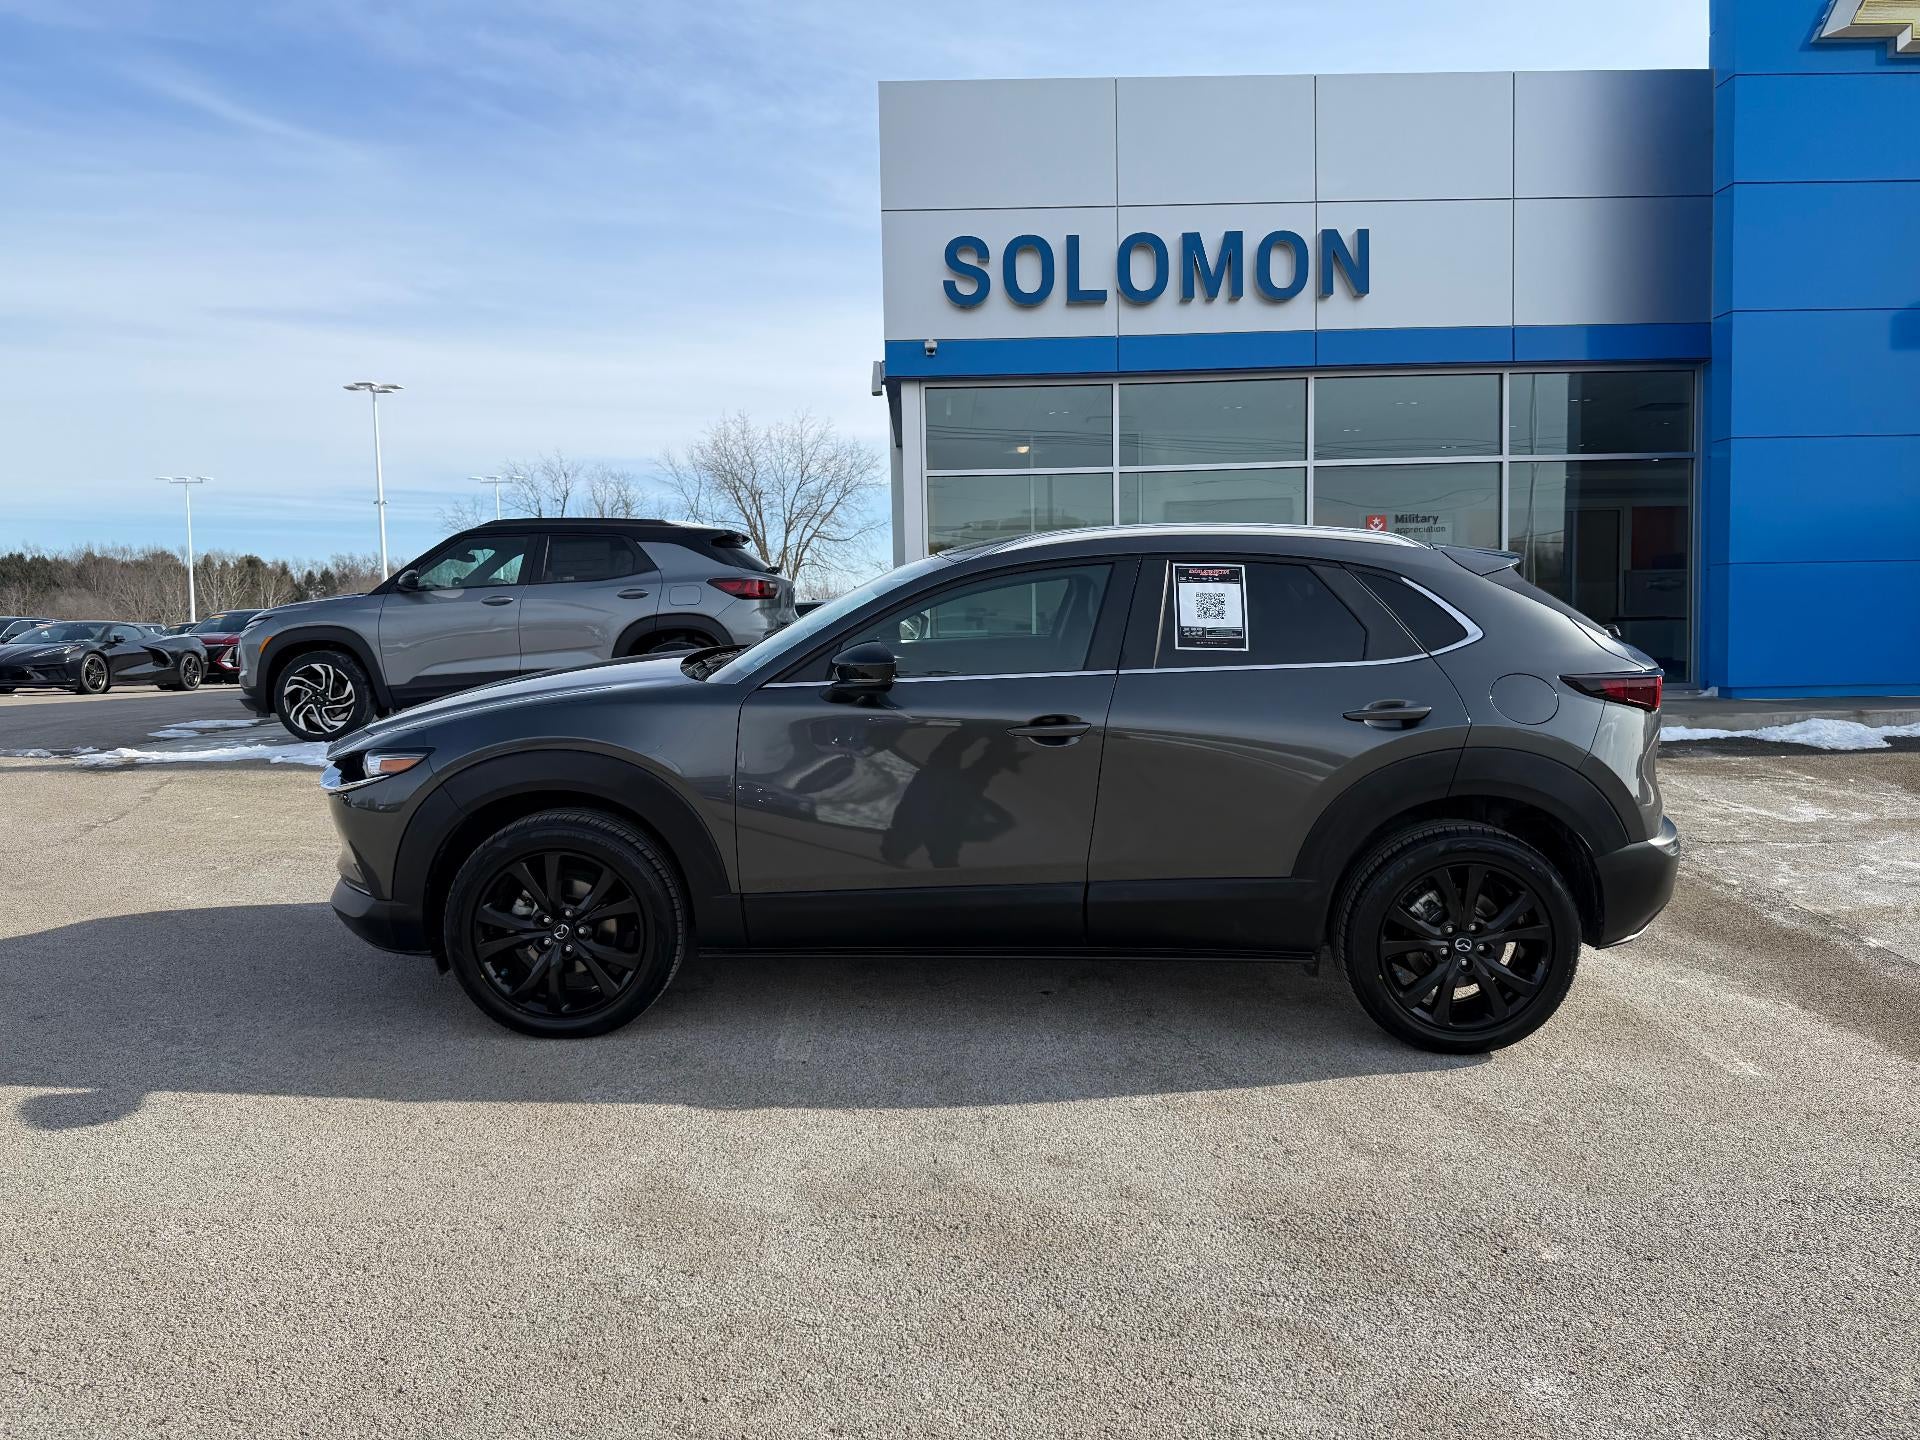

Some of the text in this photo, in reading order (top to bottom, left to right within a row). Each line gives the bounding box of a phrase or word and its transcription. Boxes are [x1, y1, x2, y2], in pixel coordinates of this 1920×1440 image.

[942, 228, 1370, 308] SOLOMON
[1395, 513, 1439, 525] Military
[1395, 525, 1446, 535] appreciation
